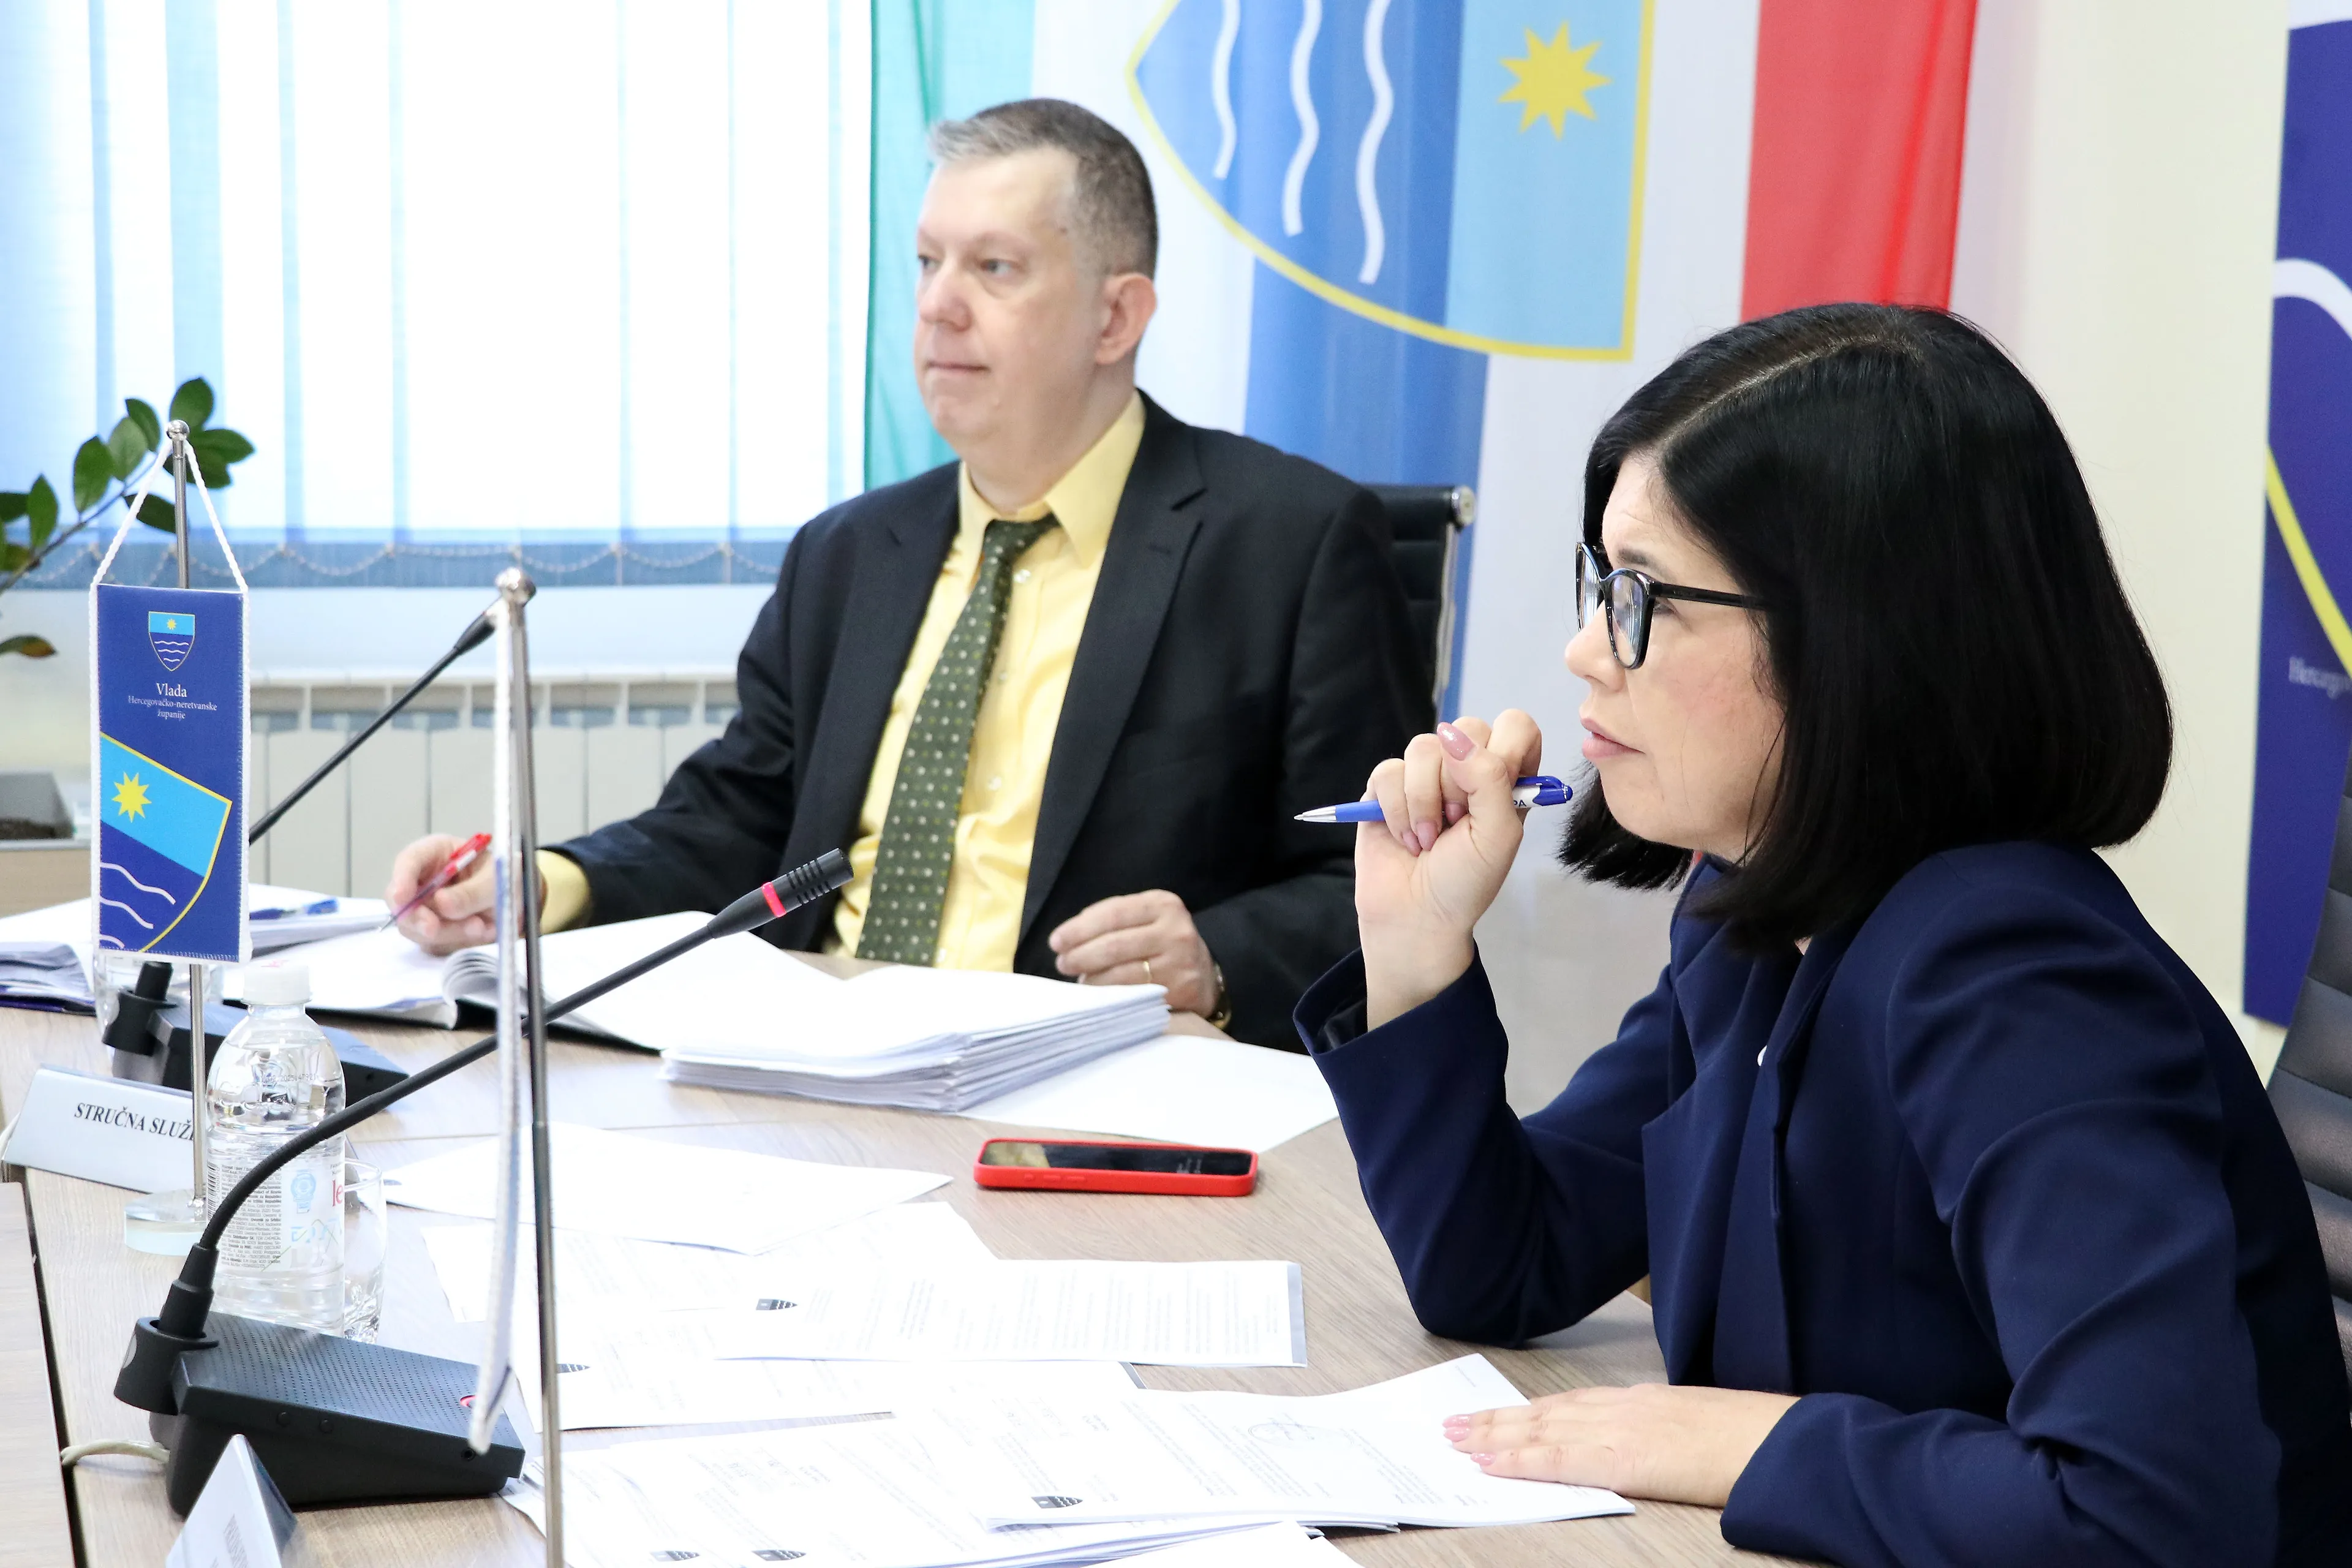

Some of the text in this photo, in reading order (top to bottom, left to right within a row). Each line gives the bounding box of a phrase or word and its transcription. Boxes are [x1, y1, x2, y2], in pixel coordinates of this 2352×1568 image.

[156, 682, 187, 698] Vlada
[128, 696, 217, 711] Hercegovačko-neretvanske
[157, 710, 186, 722] županije
[74, 1102, 146, 1131] STRUČNA
